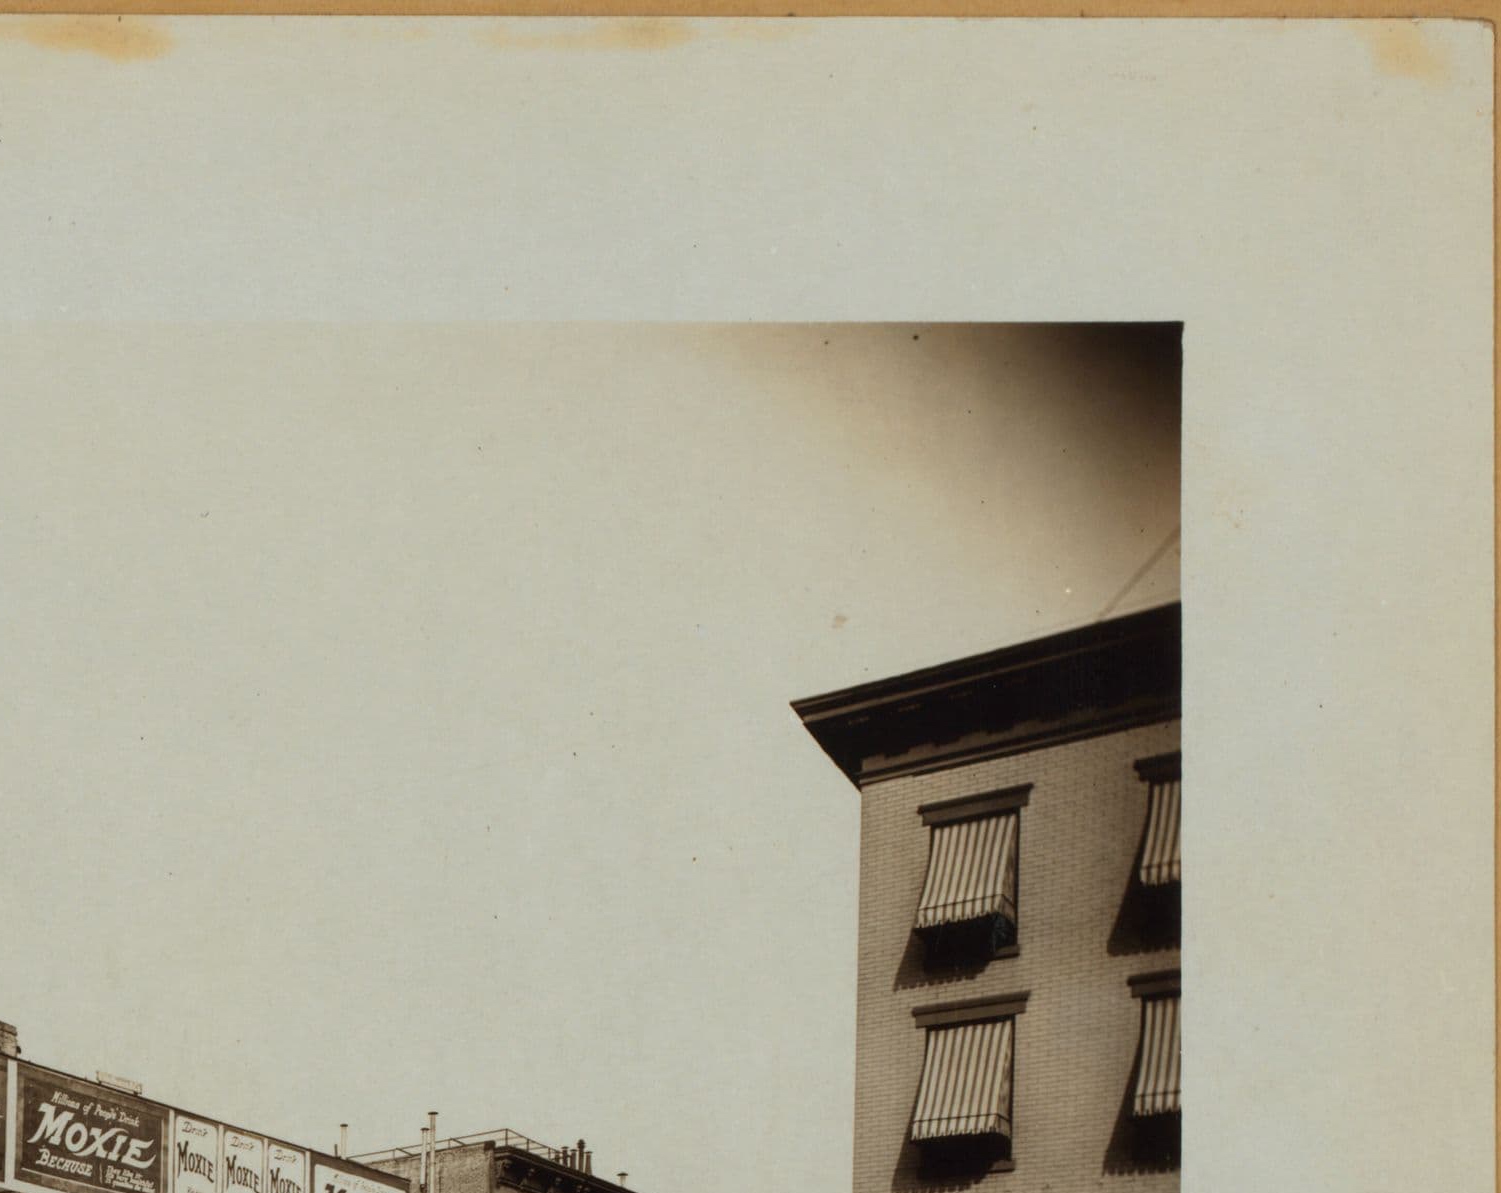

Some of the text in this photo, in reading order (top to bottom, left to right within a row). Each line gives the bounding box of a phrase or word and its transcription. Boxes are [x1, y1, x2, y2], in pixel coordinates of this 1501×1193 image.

[51, 1090, 81, 1110] Millions
[82, 1102, 95, 1115] of
[118, 1111, 140, 1128] Drink
[27, 1102, 157, 1170] MOXIE
[35, 1148, 93, 1178] BECAUSE
[177, 1141, 215, 1184] MOXIE
